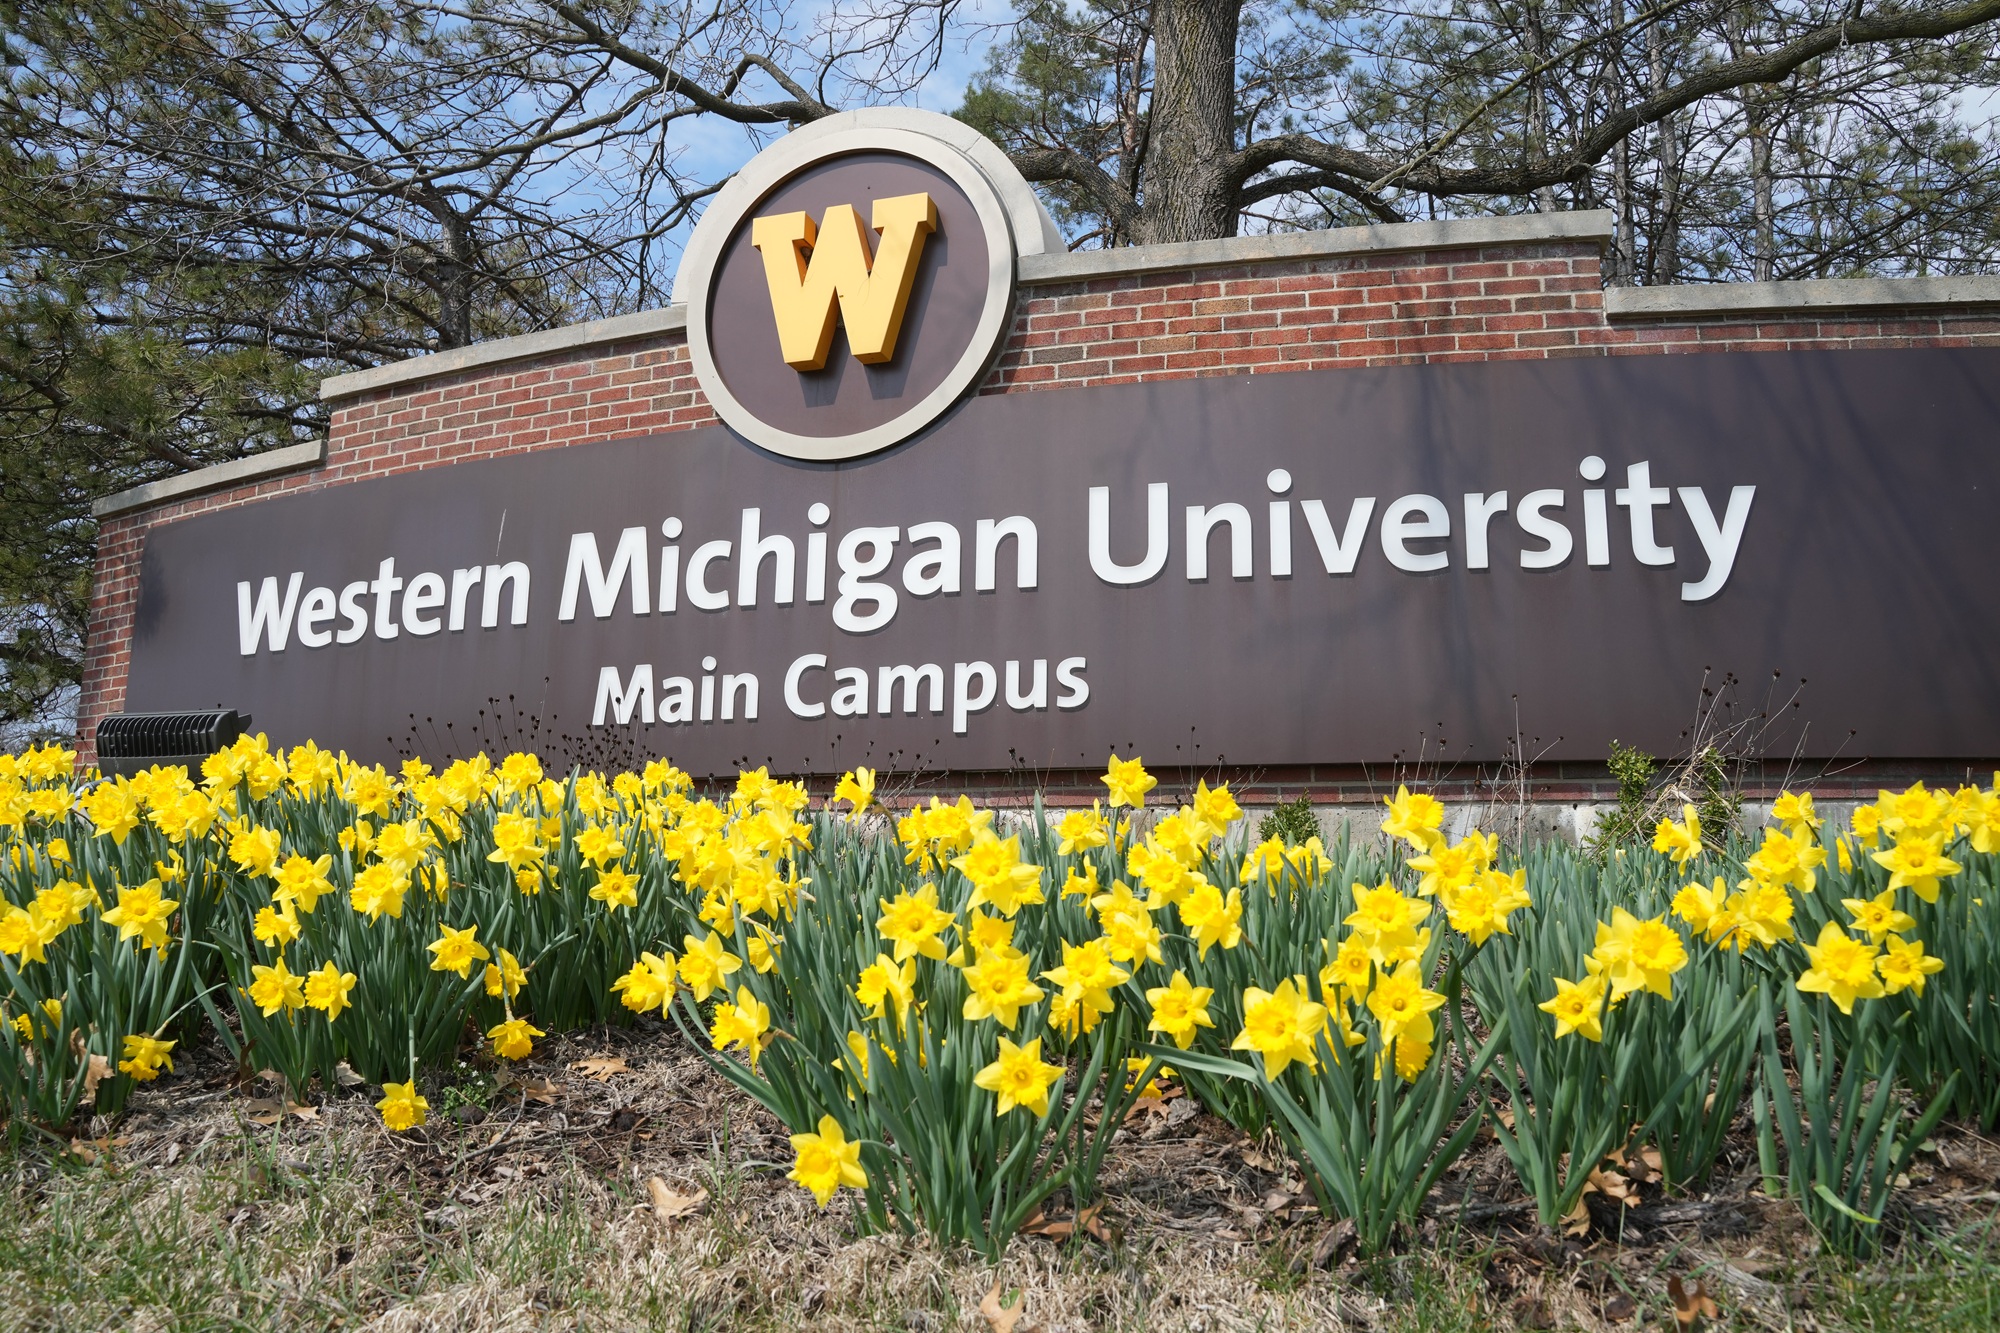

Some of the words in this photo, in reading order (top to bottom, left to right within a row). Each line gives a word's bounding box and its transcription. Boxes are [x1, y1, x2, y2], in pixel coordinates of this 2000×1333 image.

[751, 191, 937, 371] W
[237, 557, 531, 656] Western
[558, 503, 1038, 633] Michigan
[1088, 456, 1757, 602] University
[591, 656, 759, 727] Main
[783, 653, 1090, 734] Campus
